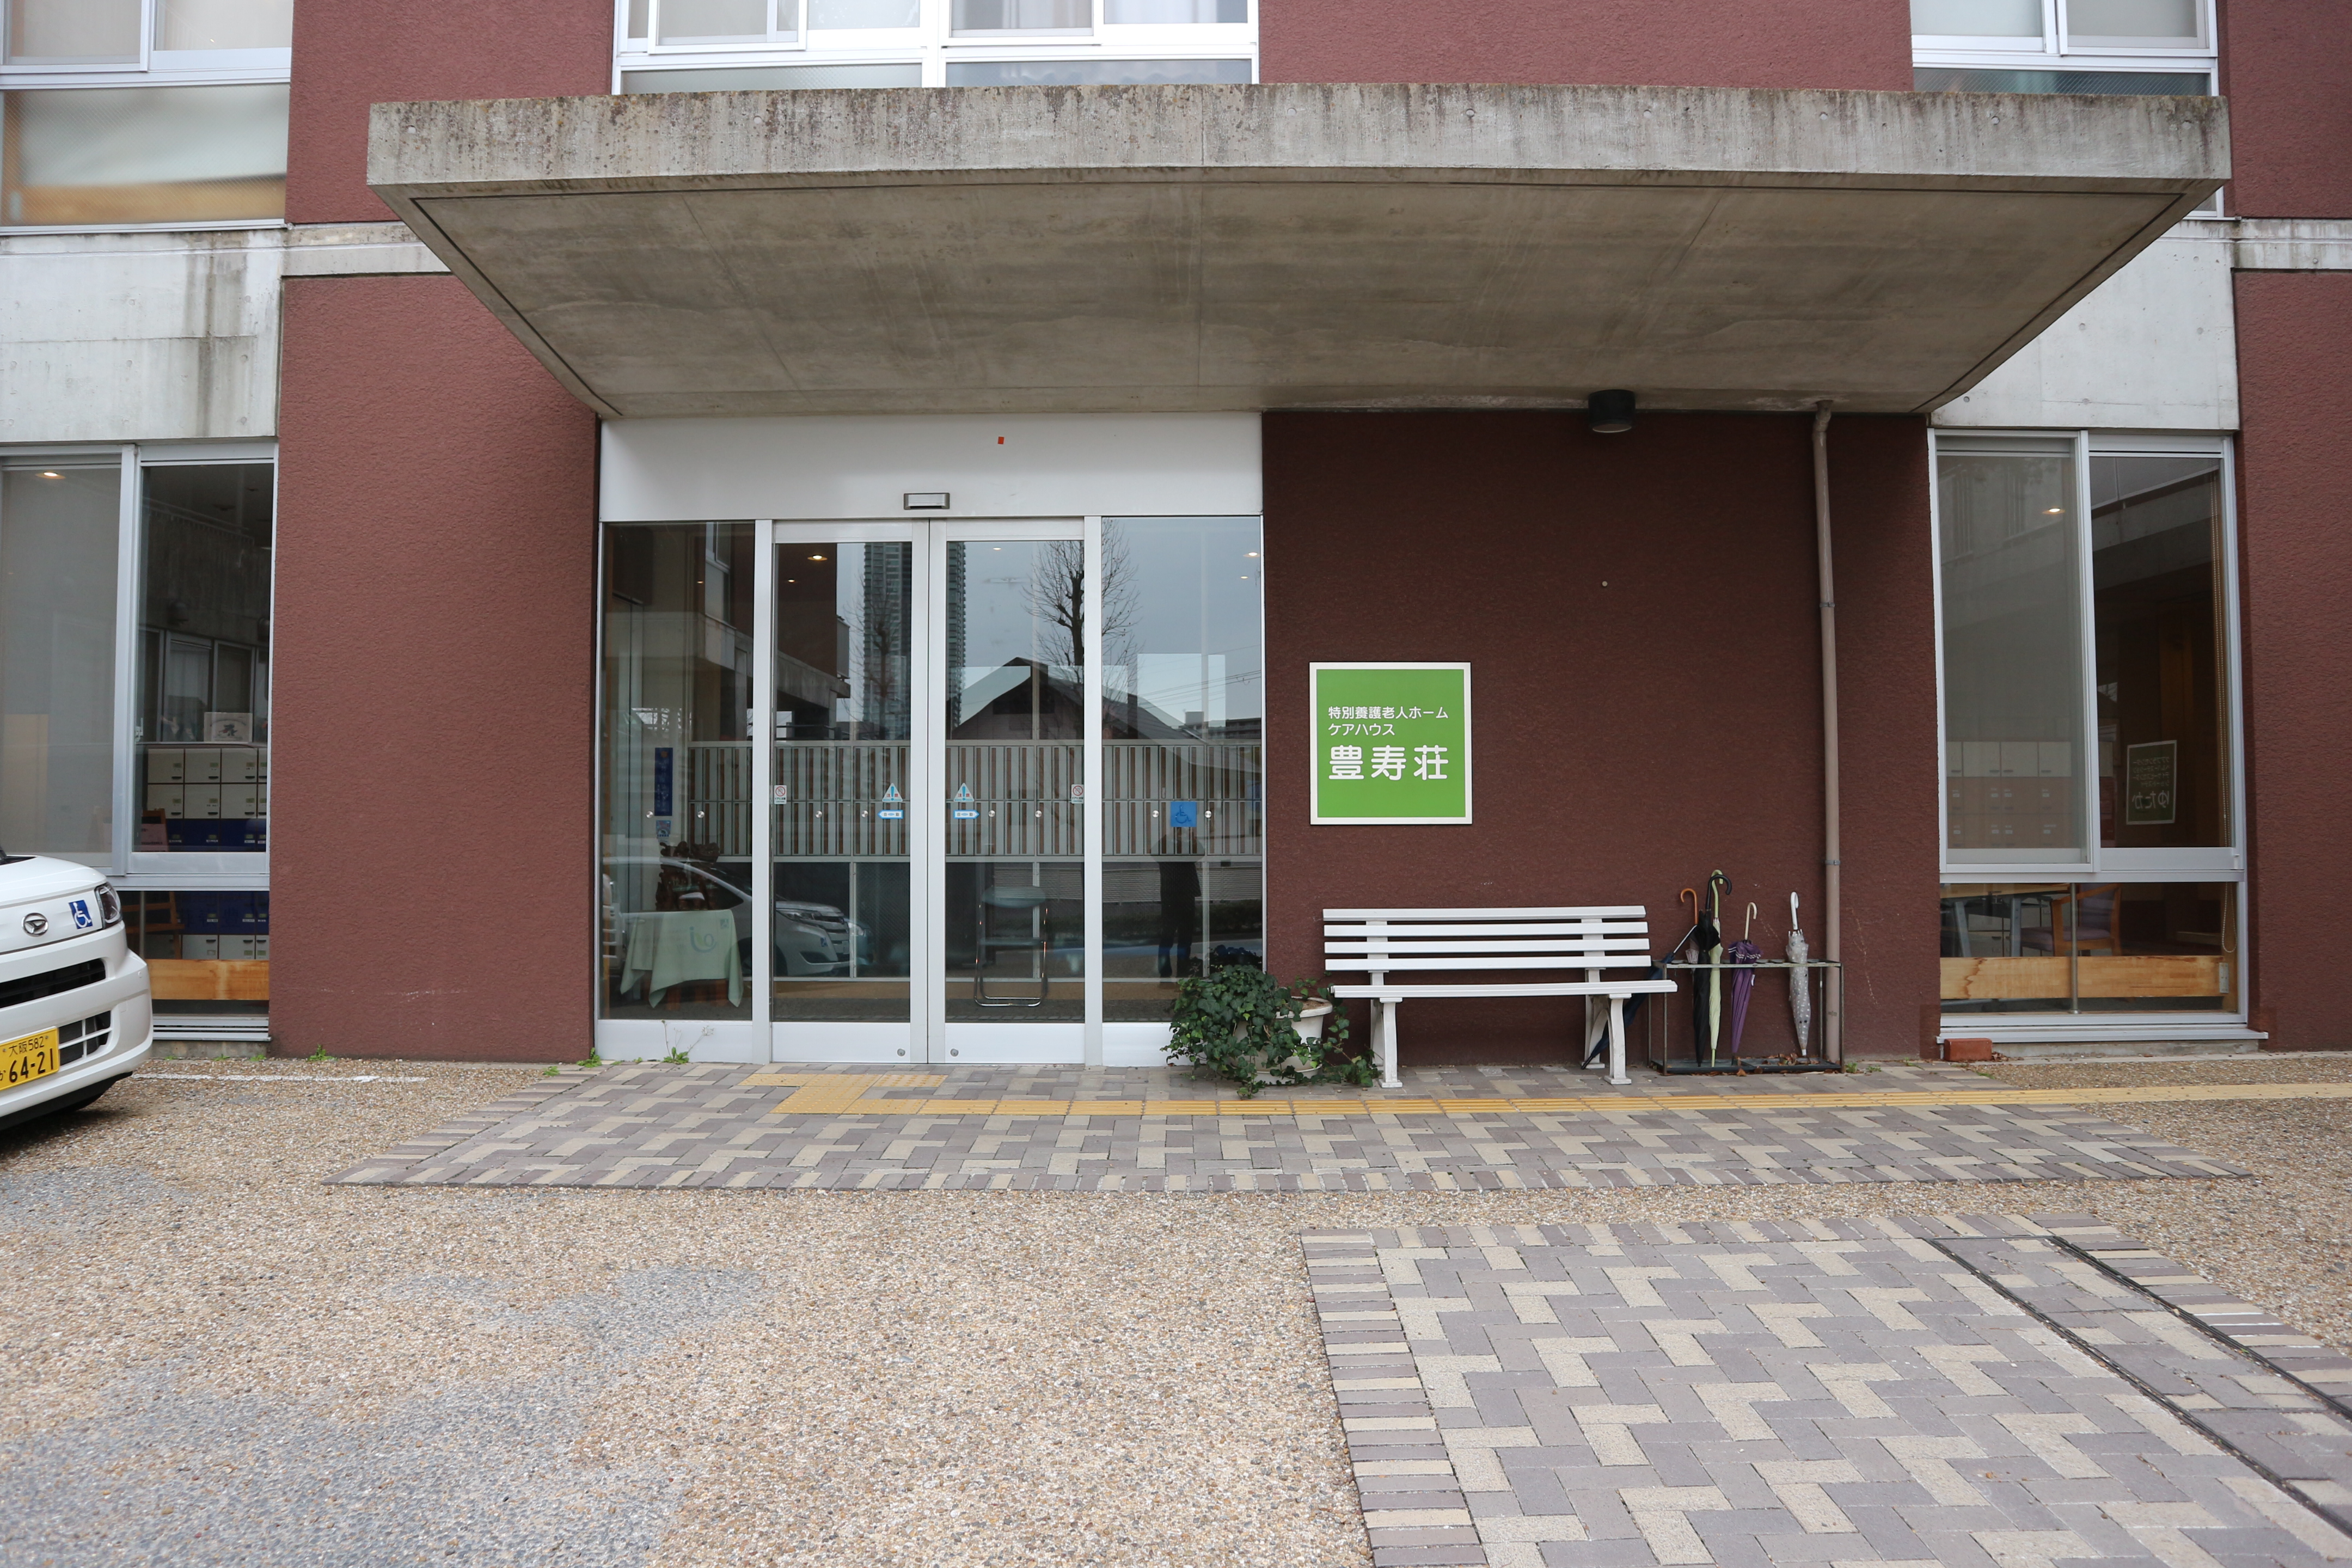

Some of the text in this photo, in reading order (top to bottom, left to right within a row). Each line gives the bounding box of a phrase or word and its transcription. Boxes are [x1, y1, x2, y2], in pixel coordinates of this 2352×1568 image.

[1328, 706, 1449, 719] 特別養護老人ホーム
[1328, 723, 1395, 736] ケアハウス
[1328, 744, 1449, 781] 豊寿荘
[9, 1048, 54, 1083] 64-21
